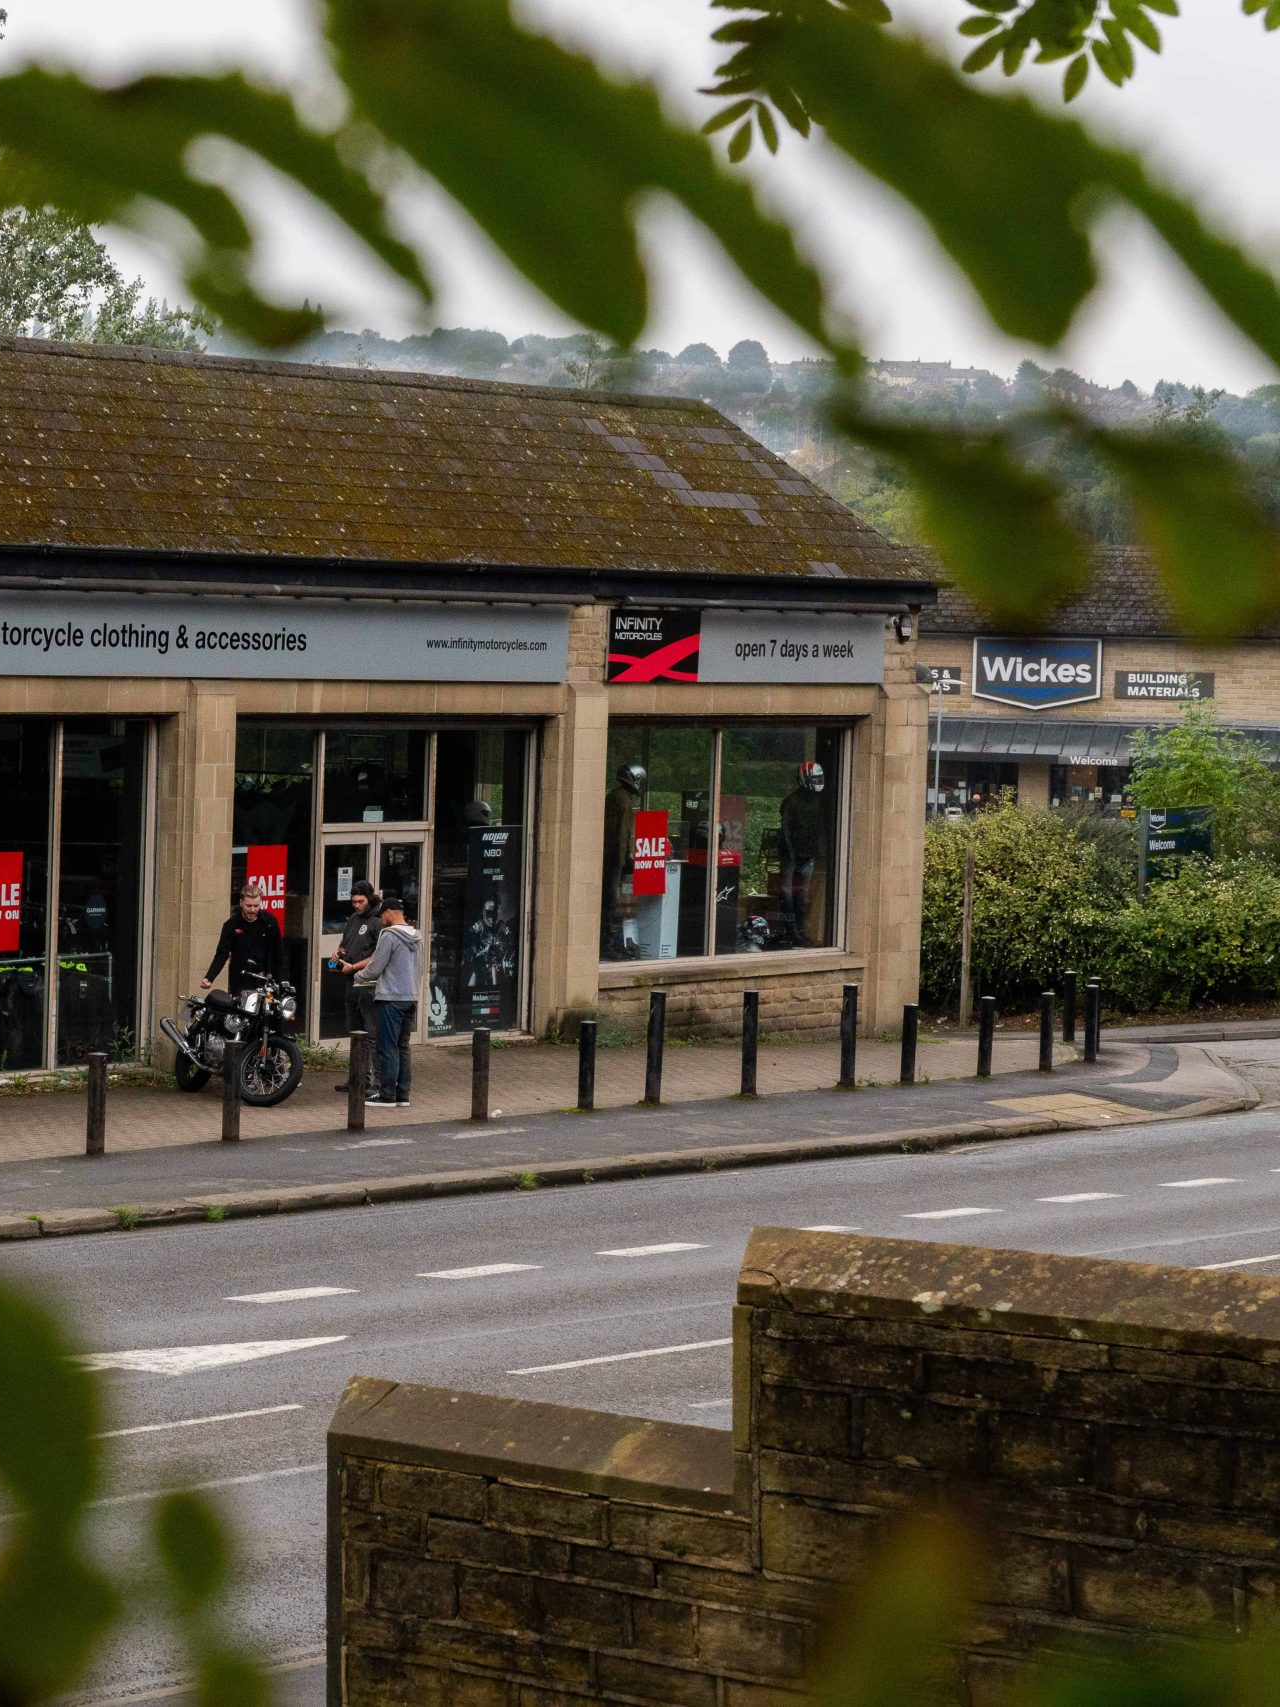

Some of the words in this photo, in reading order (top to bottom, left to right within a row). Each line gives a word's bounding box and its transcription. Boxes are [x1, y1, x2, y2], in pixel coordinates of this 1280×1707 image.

[615, 616, 663, 630] INFINITY
[90, 623, 170, 655] clothing
[176, 625, 190, 649] &
[195, 628, 308, 652] accessories
[614, 632, 663, 641] MOTORCYCLES
[426, 637, 548, 653] www.infinitymotorcycles.com
[734, 642, 766, 661] open
[769, 640, 777, 658] 7
[780, 639, 809, 662] days
[811, 643, 819, 658] a
[822, 640, 854, 659] week
[942, 669, 951, 679] &
[981, 656, 1092, 684] Wickes
[1128, 673, 1187, 685] BUILDING
[1070, 755, 1118, 766] Welcome
[482, 833, 509, 844] NOLAN
[635, 837, 666, 858] SALE
[1149, 840, 1176, 851] Welcome
[634, 861, 652, 869] NOW
[654, 860, 665, 868] ON
[271, 900, 284, 909] ON
[4, 909, 20, 920] ON
